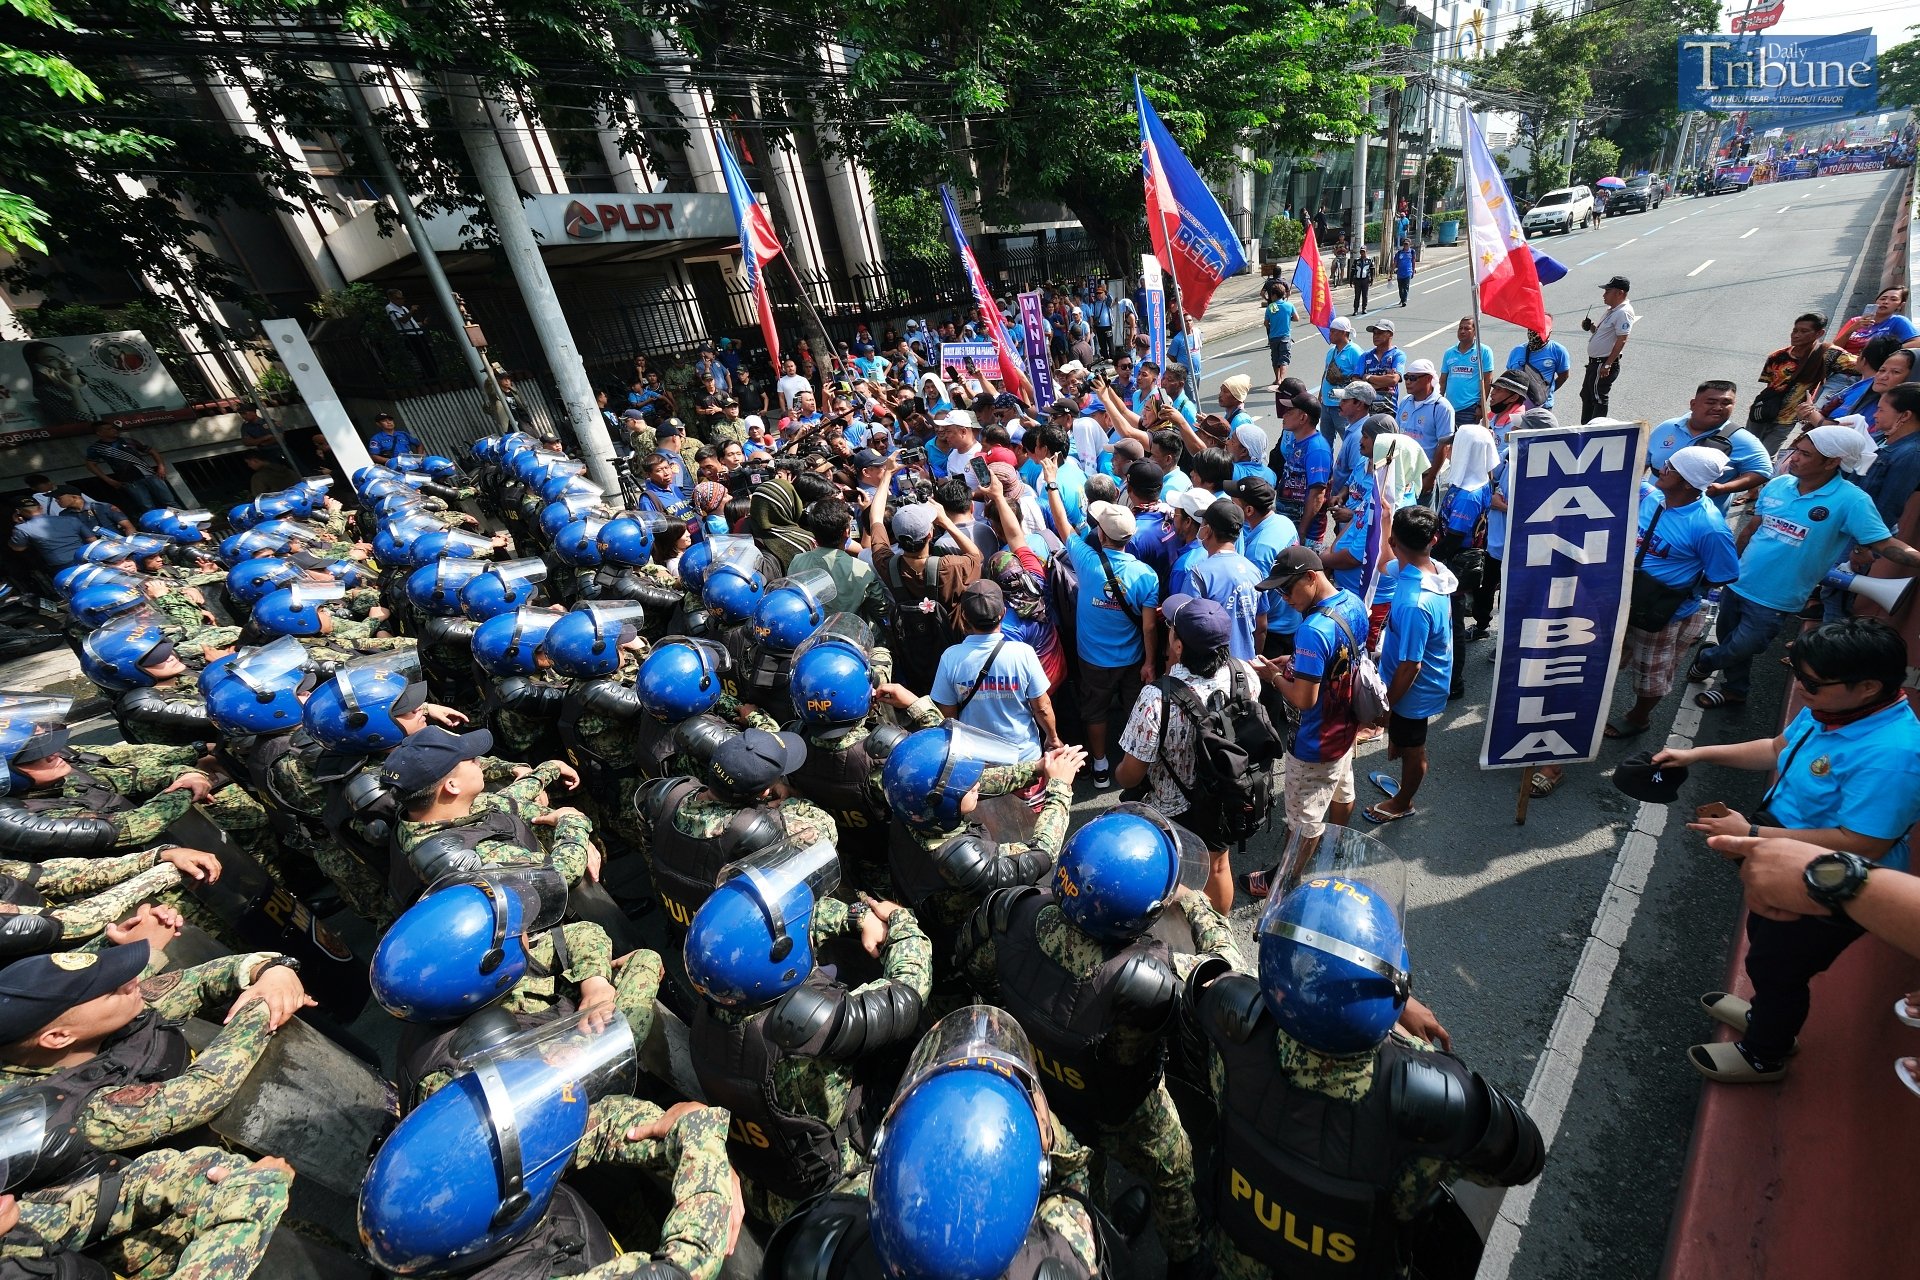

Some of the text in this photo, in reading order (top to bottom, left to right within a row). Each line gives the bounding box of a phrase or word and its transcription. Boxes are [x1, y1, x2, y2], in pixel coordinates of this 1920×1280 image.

[1734, 14, 1776, 30] Jibee
[1819, 161, 1884, 176] NO TO PUV PHASEOUT
[595, 204, 674, 232] PLDT
[944, 357, 1000, 371] MANBELA
[1226, 595, 1235, 610] NO
[1500, 435, 1627, 759] MANIBELA
[755, 626, 771, 638] PNP
[807, 700, 832, 712] PNP
[713, 762, 734, 785] PULIS
[1058, 866, 1079, 897] PNP
[1309, 879, 1370, 906] PULIS
[1029, 1044, 1086, 1090] LIS
[728, 1118, 770, 1149] LIS
[1231, 1167, 1356, 1263] PULIS
